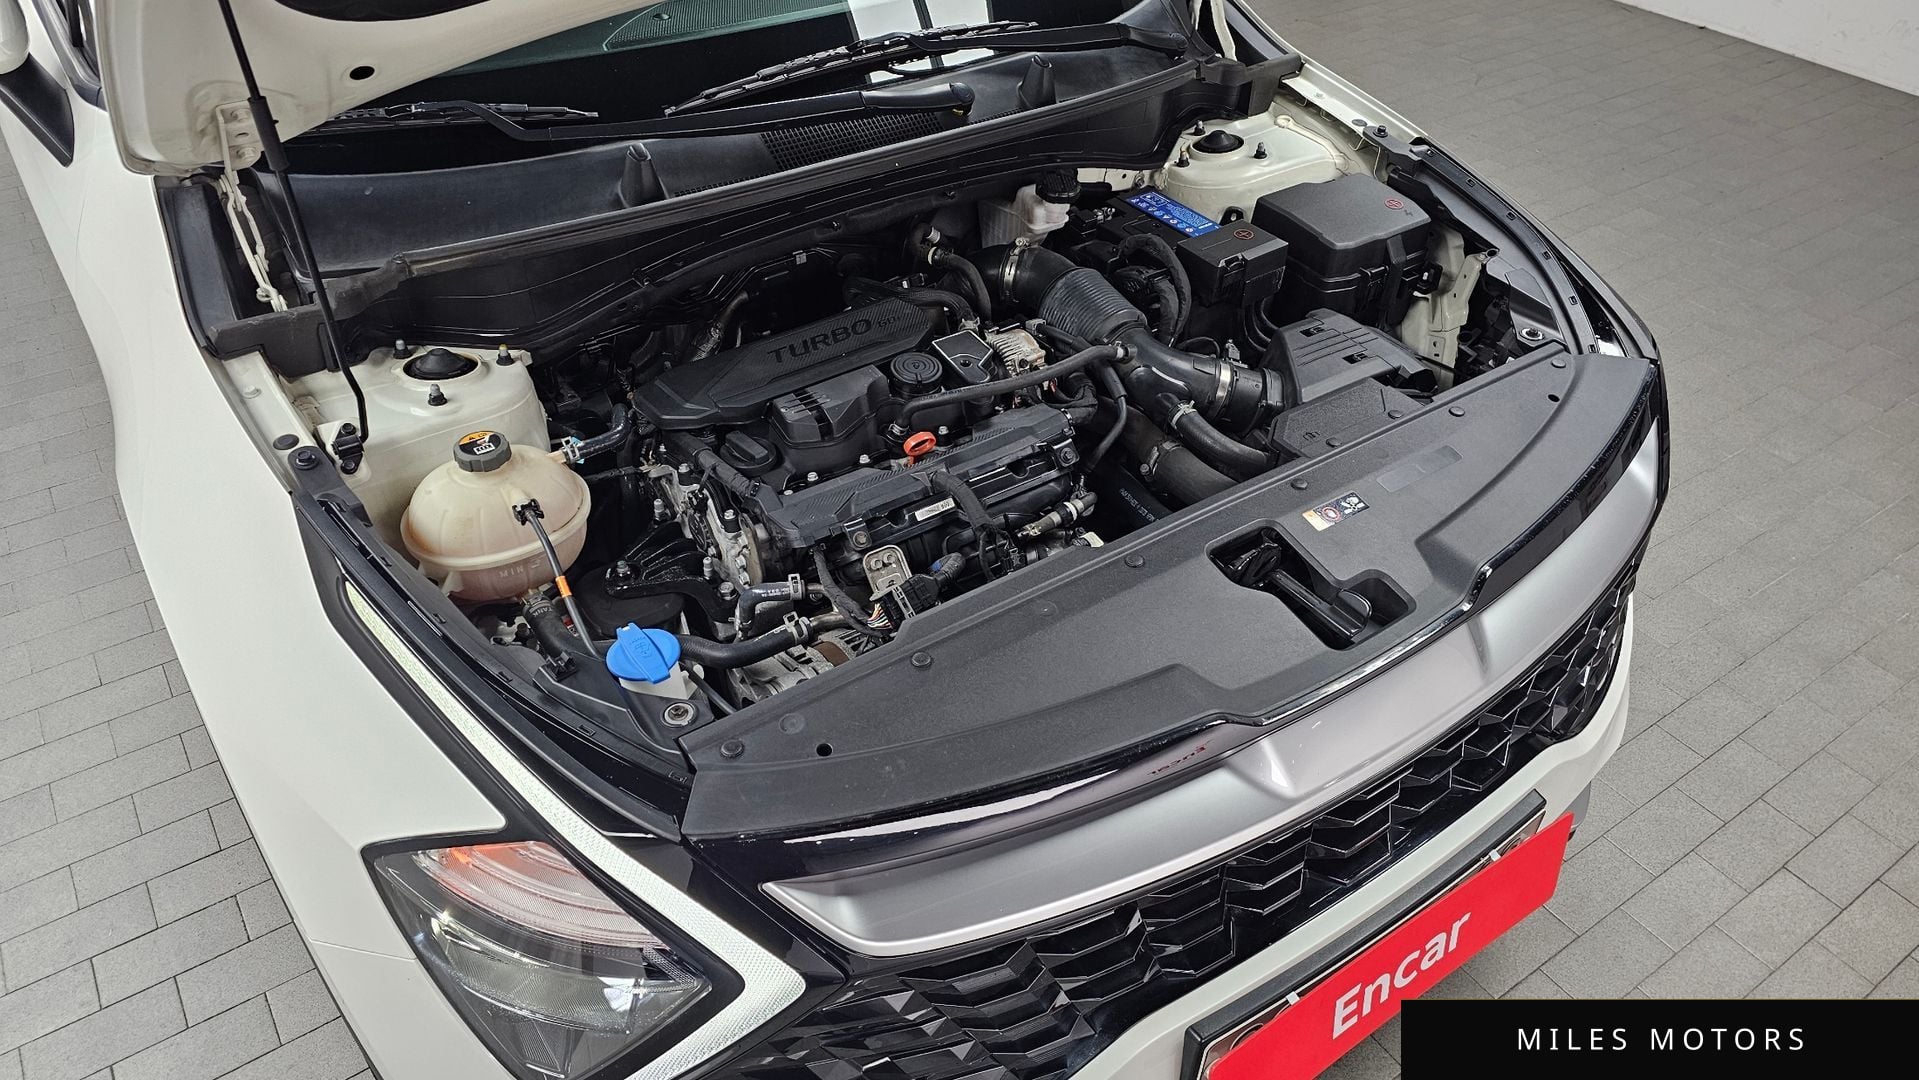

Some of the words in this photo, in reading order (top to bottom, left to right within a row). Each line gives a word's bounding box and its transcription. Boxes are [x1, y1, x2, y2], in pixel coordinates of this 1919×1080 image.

[767, 319, 872, 363] TURBO
[499, 565, 523, 578] MIN
[1332, 911, 1472, 1040] Encar
